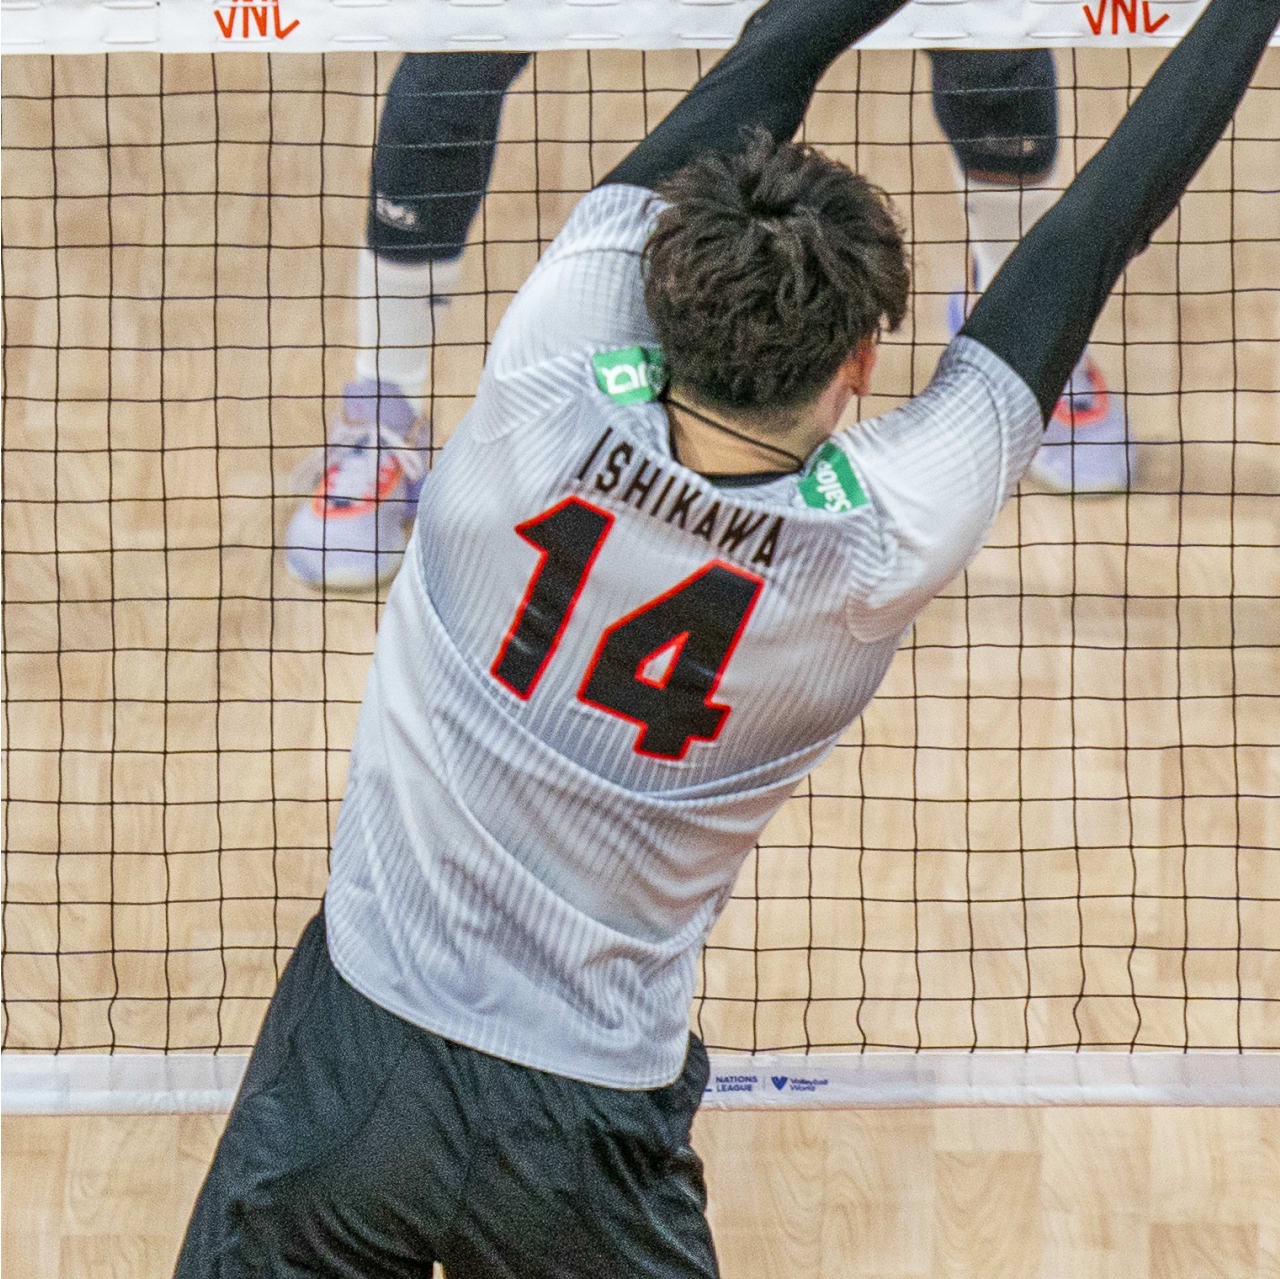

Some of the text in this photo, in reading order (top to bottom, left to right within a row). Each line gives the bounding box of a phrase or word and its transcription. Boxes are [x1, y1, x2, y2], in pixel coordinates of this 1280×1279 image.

[577, 427, 786, 568] ISHIKAWA
[489, 494, 766, 762] 14
[716, 1075, 758, 1083] NATIONS
[717, 1083, 753, 1092] LEAGUE
